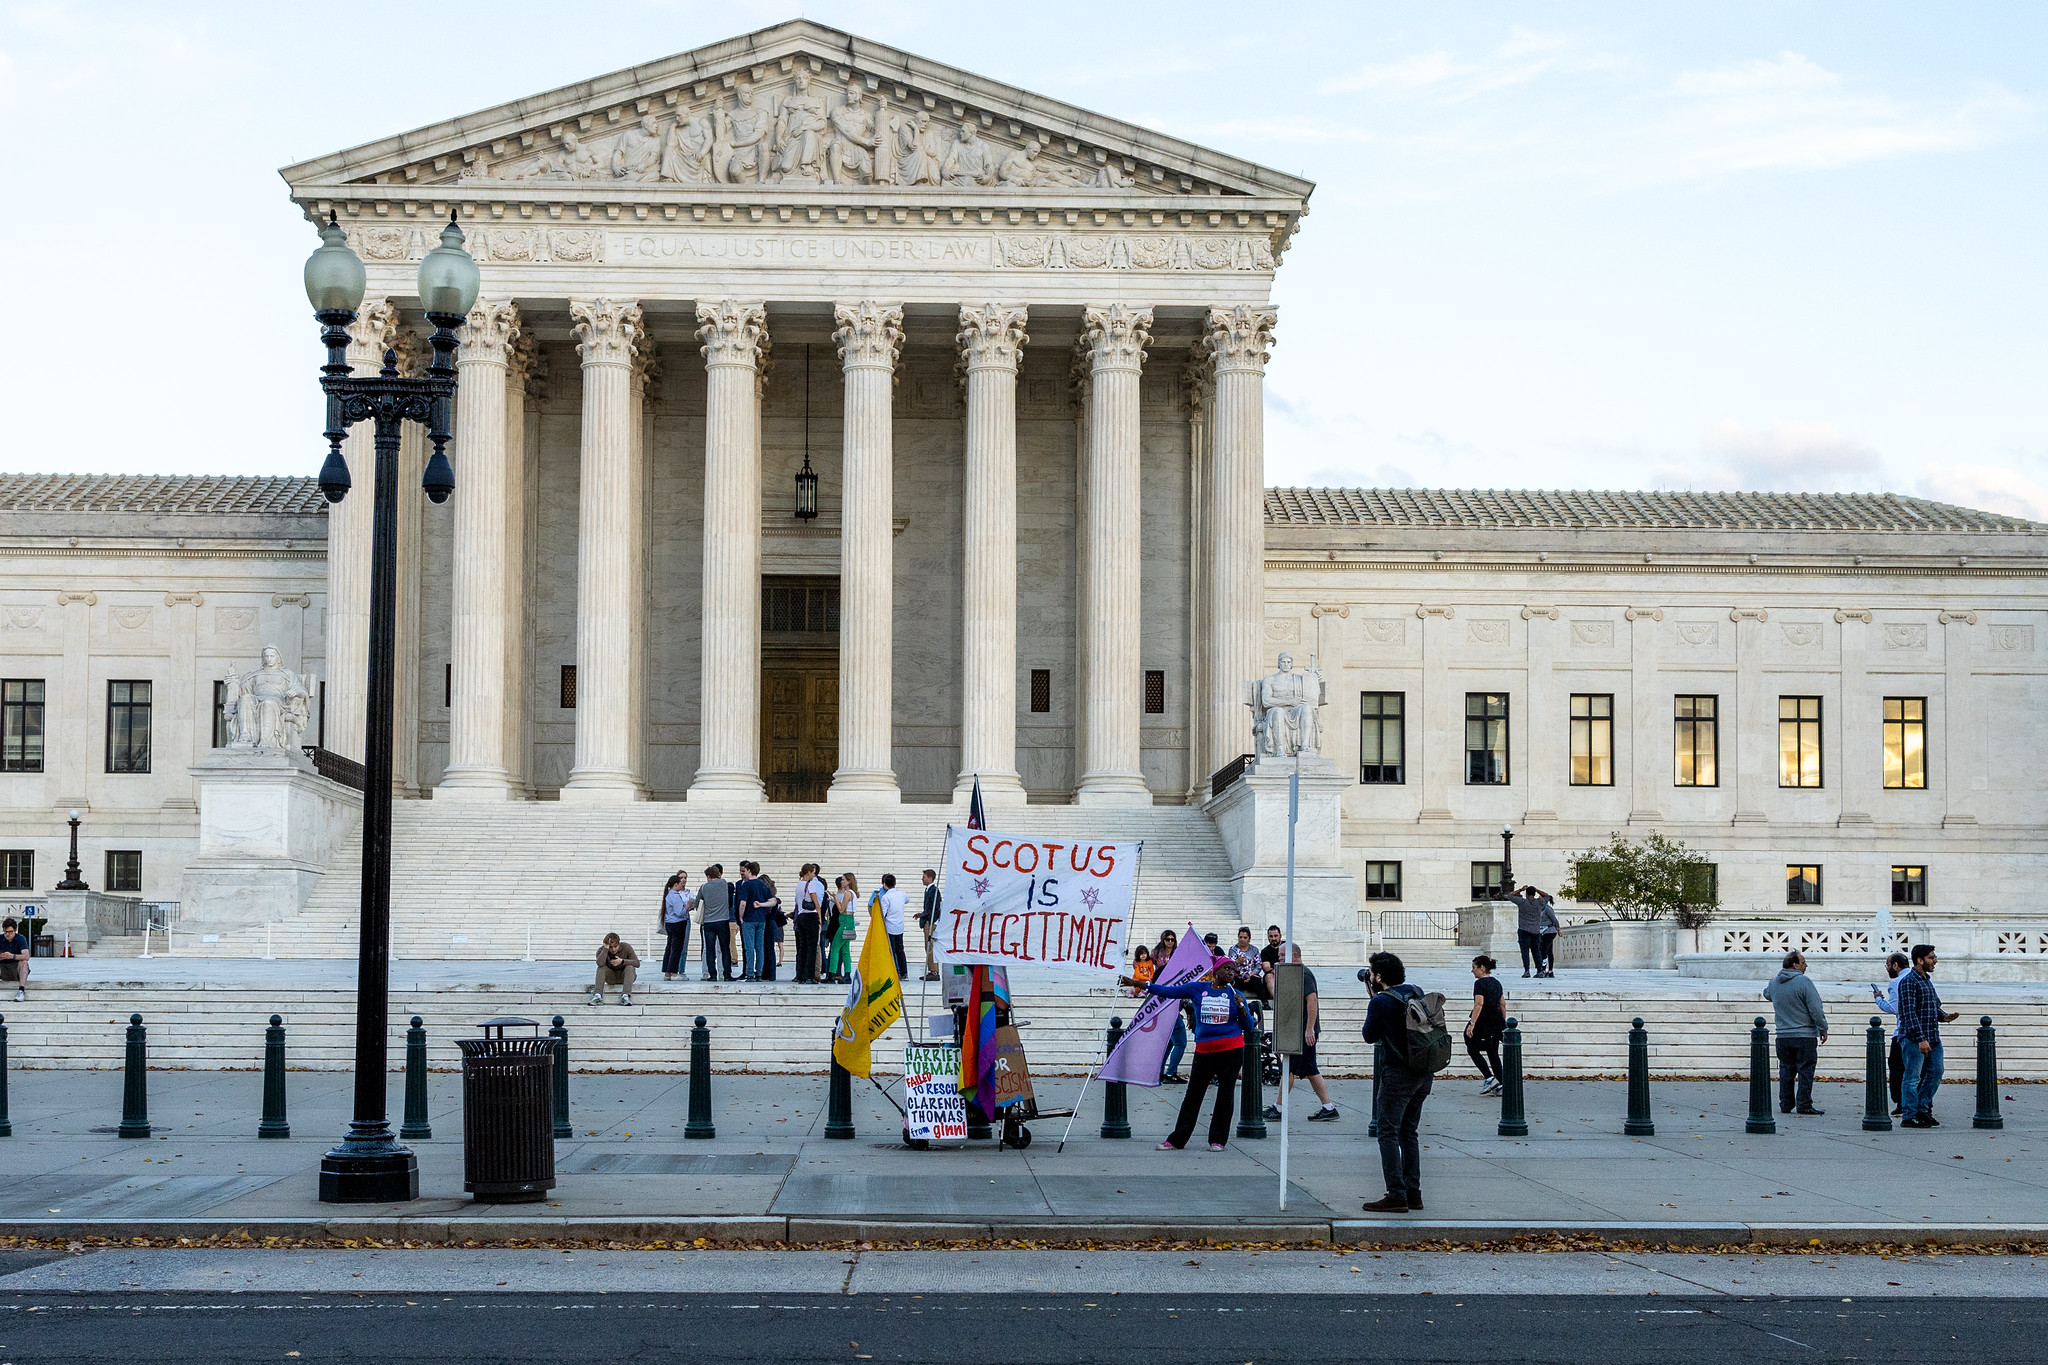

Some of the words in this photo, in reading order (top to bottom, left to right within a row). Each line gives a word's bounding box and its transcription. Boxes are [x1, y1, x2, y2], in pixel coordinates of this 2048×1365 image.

[623, 237, 710, 258] EQUAL
[716, 237, 817, 259] JUSTICE
[832, 239, 919, 260] UNDER
[928, 240, 978, 260] LAW
[962, 834, 1116, 878] SCOTUS
[946, 909, 1123, 970] ILLEGITIMATE
[1144, 999, 1159, 1015] ON
[1172, 964, 1205, 988] TERUS
[905, 1048, 961, 1062] HARRIET
[905, 1061, 961, 1076] TUBMAN
[906, 1071, 932, 1088] FAILED
[995, 1071, 1031, 1095] SCISM
[912, 1084, 925, 1096] TO
[926, 1083, 958, 1096] RESCU
[907, 1096, 966, 1110] CLARENCE
[911, 1110, 963, 1123] THOMAS
[910, 1126, 930, 1137] from
